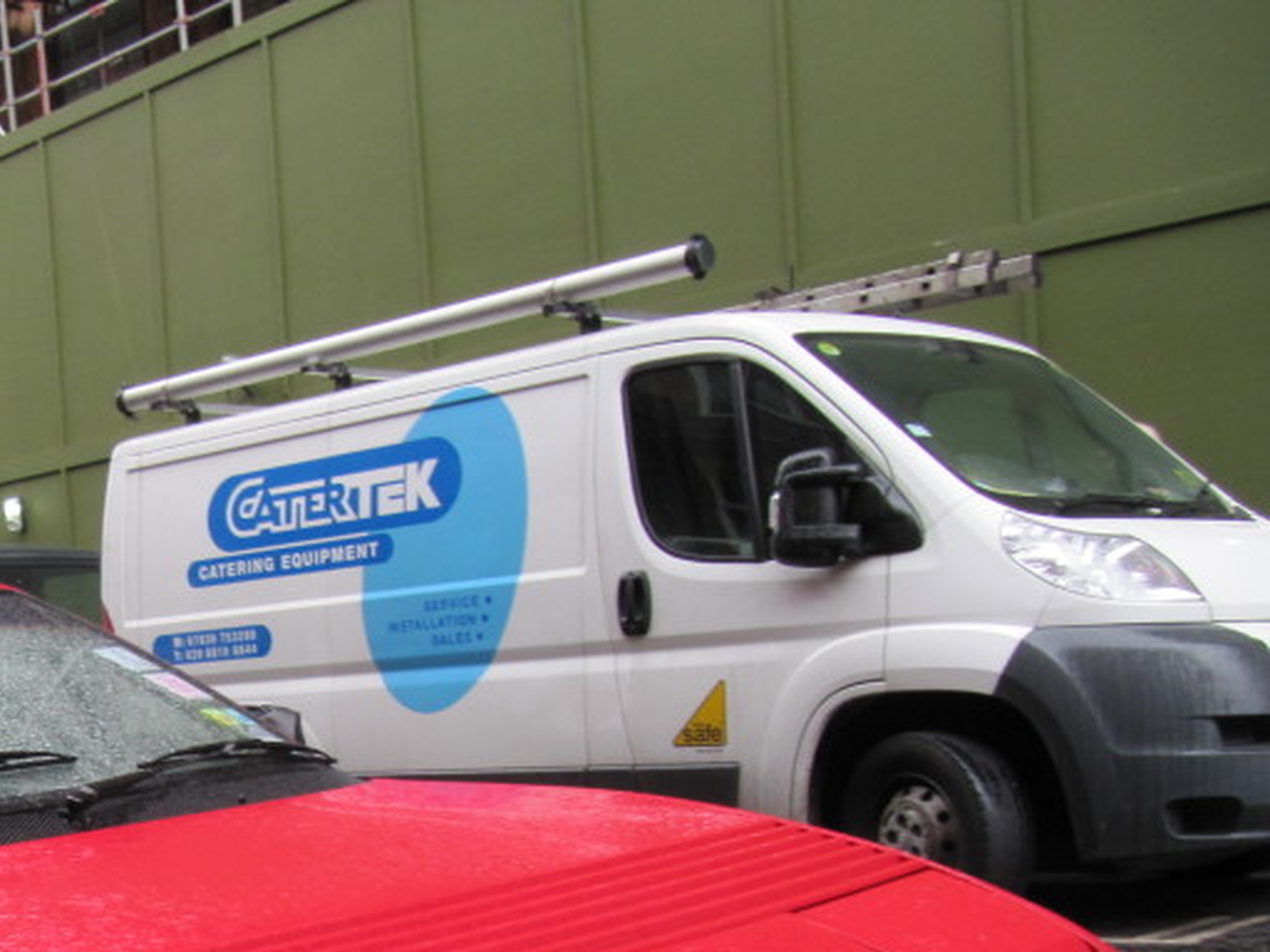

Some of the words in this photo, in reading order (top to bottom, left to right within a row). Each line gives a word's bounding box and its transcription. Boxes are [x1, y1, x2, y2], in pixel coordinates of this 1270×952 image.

[226, 458, 441, 538] CATERTEK
[198, 557, 276, 582] CATERING
[281, 541, 379, 570] EQUIPMENT
[424, 595, 478, 612] SERVICE
[433, 632, 472, 647] SALES
